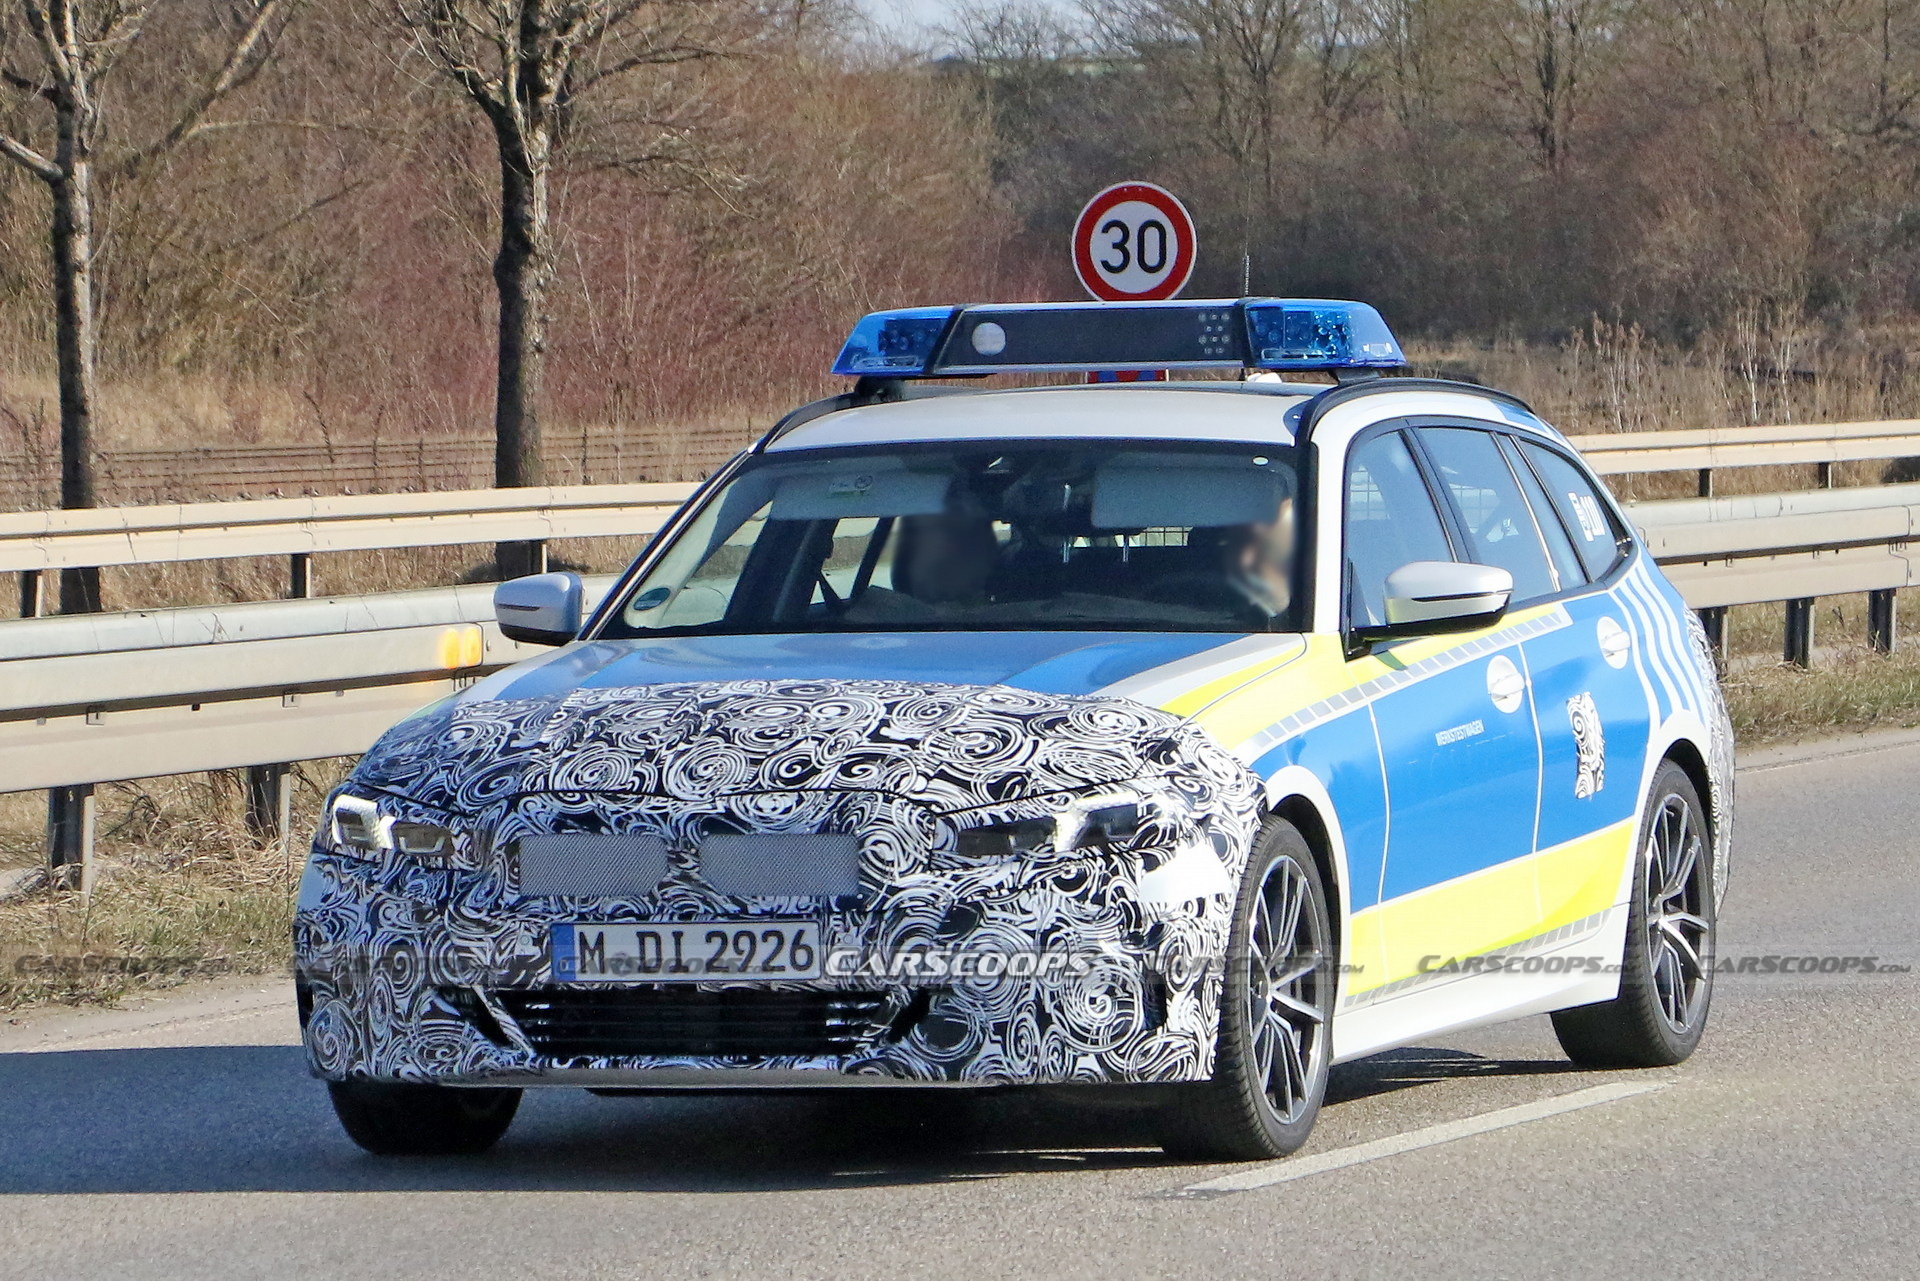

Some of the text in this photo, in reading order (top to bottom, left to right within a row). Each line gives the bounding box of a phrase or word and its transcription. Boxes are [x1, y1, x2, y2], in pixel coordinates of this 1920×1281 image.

[1100, 219, 1167, 273] 30
[579, 930, 814, 974] M DI 2926
